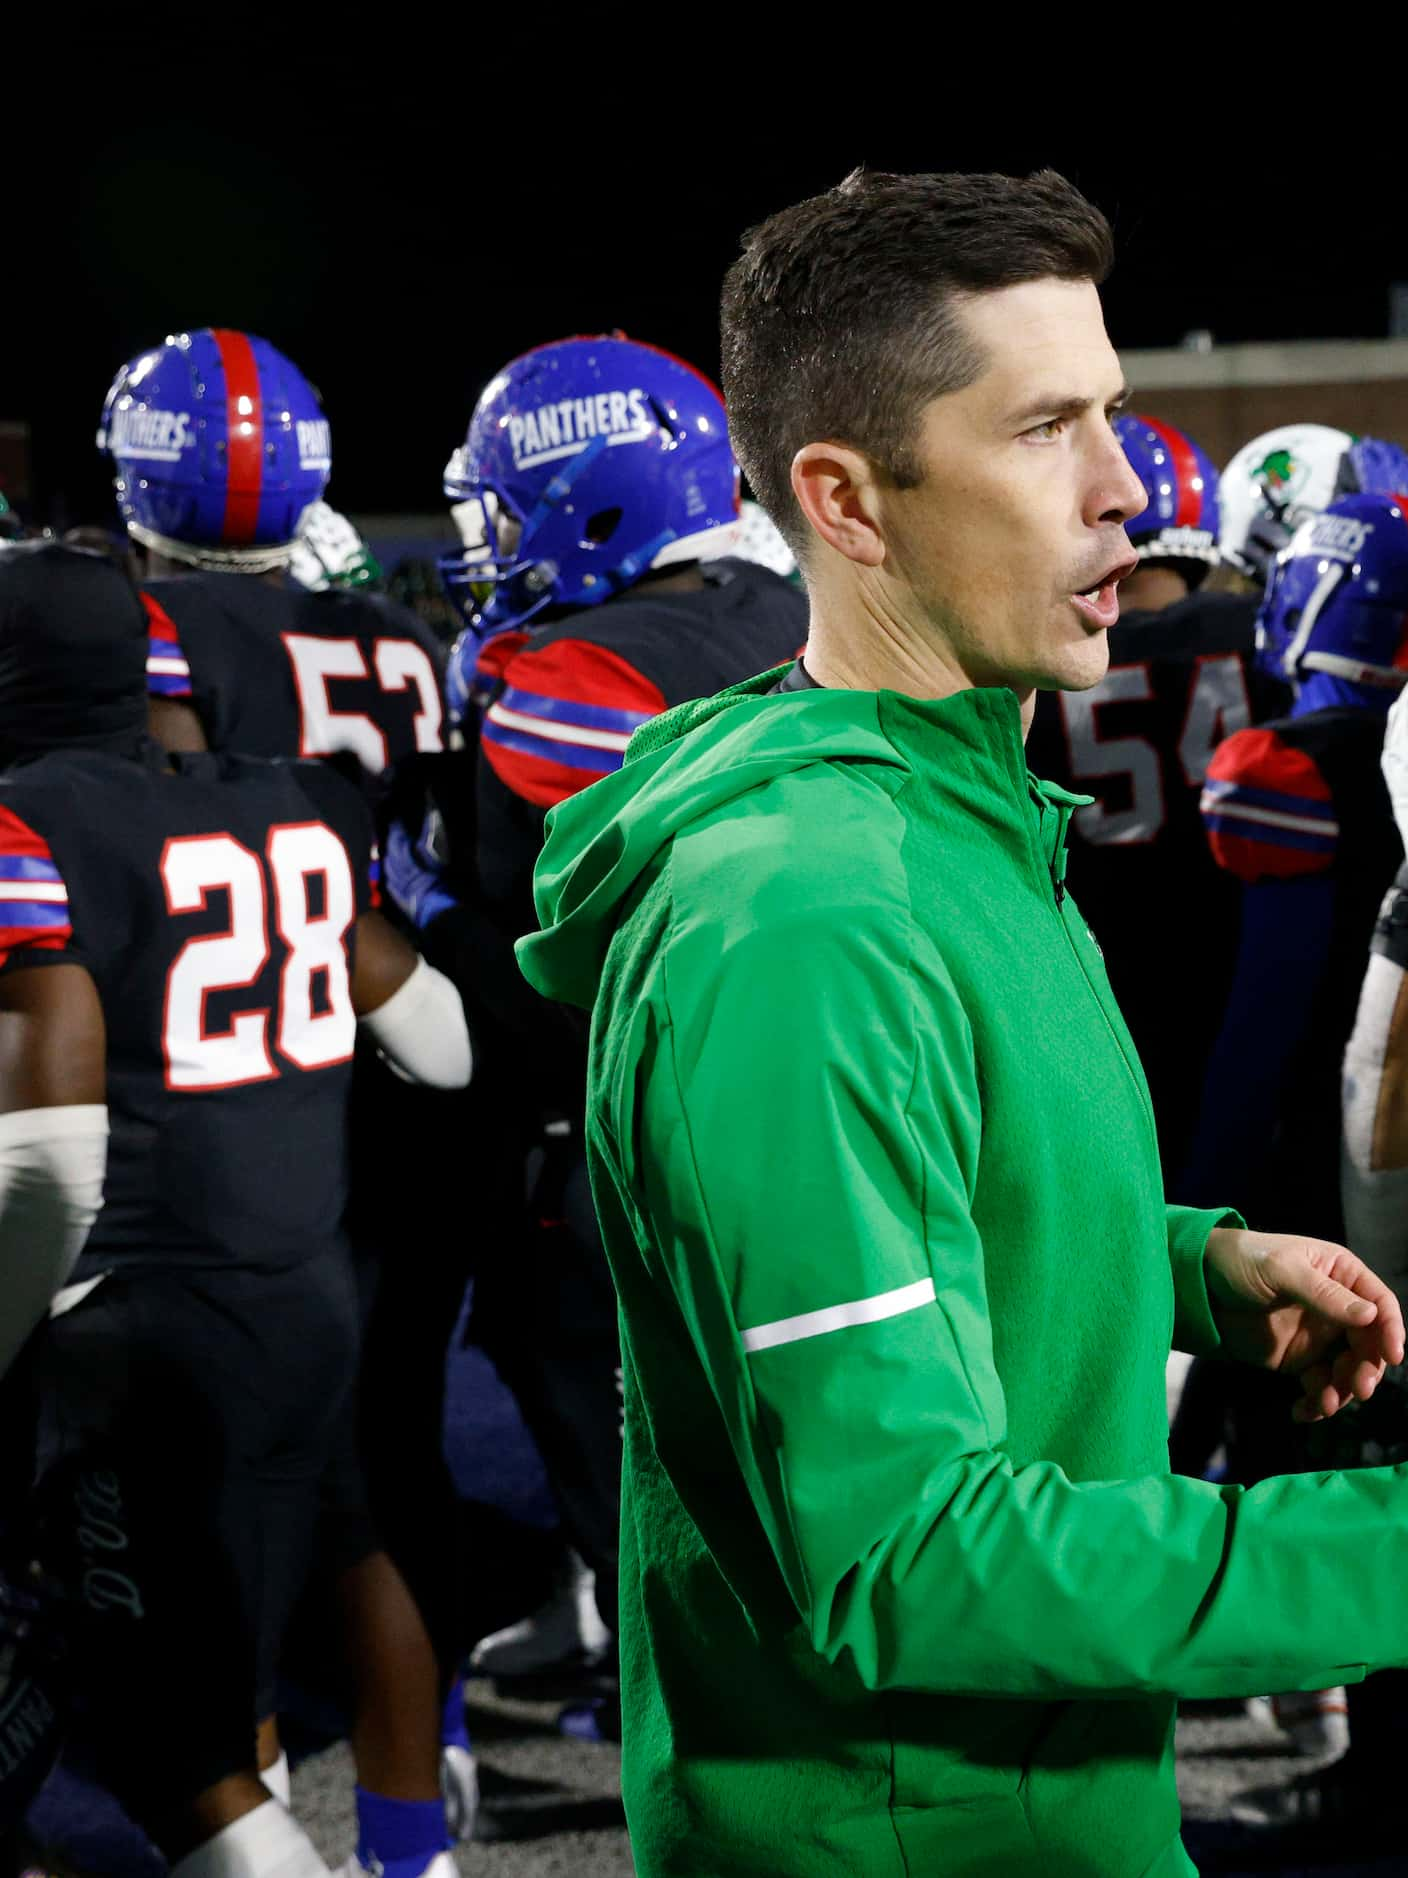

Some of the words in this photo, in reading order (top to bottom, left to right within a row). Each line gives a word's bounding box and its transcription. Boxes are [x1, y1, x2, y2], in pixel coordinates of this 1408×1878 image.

[508, 387, 651, 461] PANTHERS
[1056, 651, 1251, 847] 54
[160, 820, 358, 1093] 28
